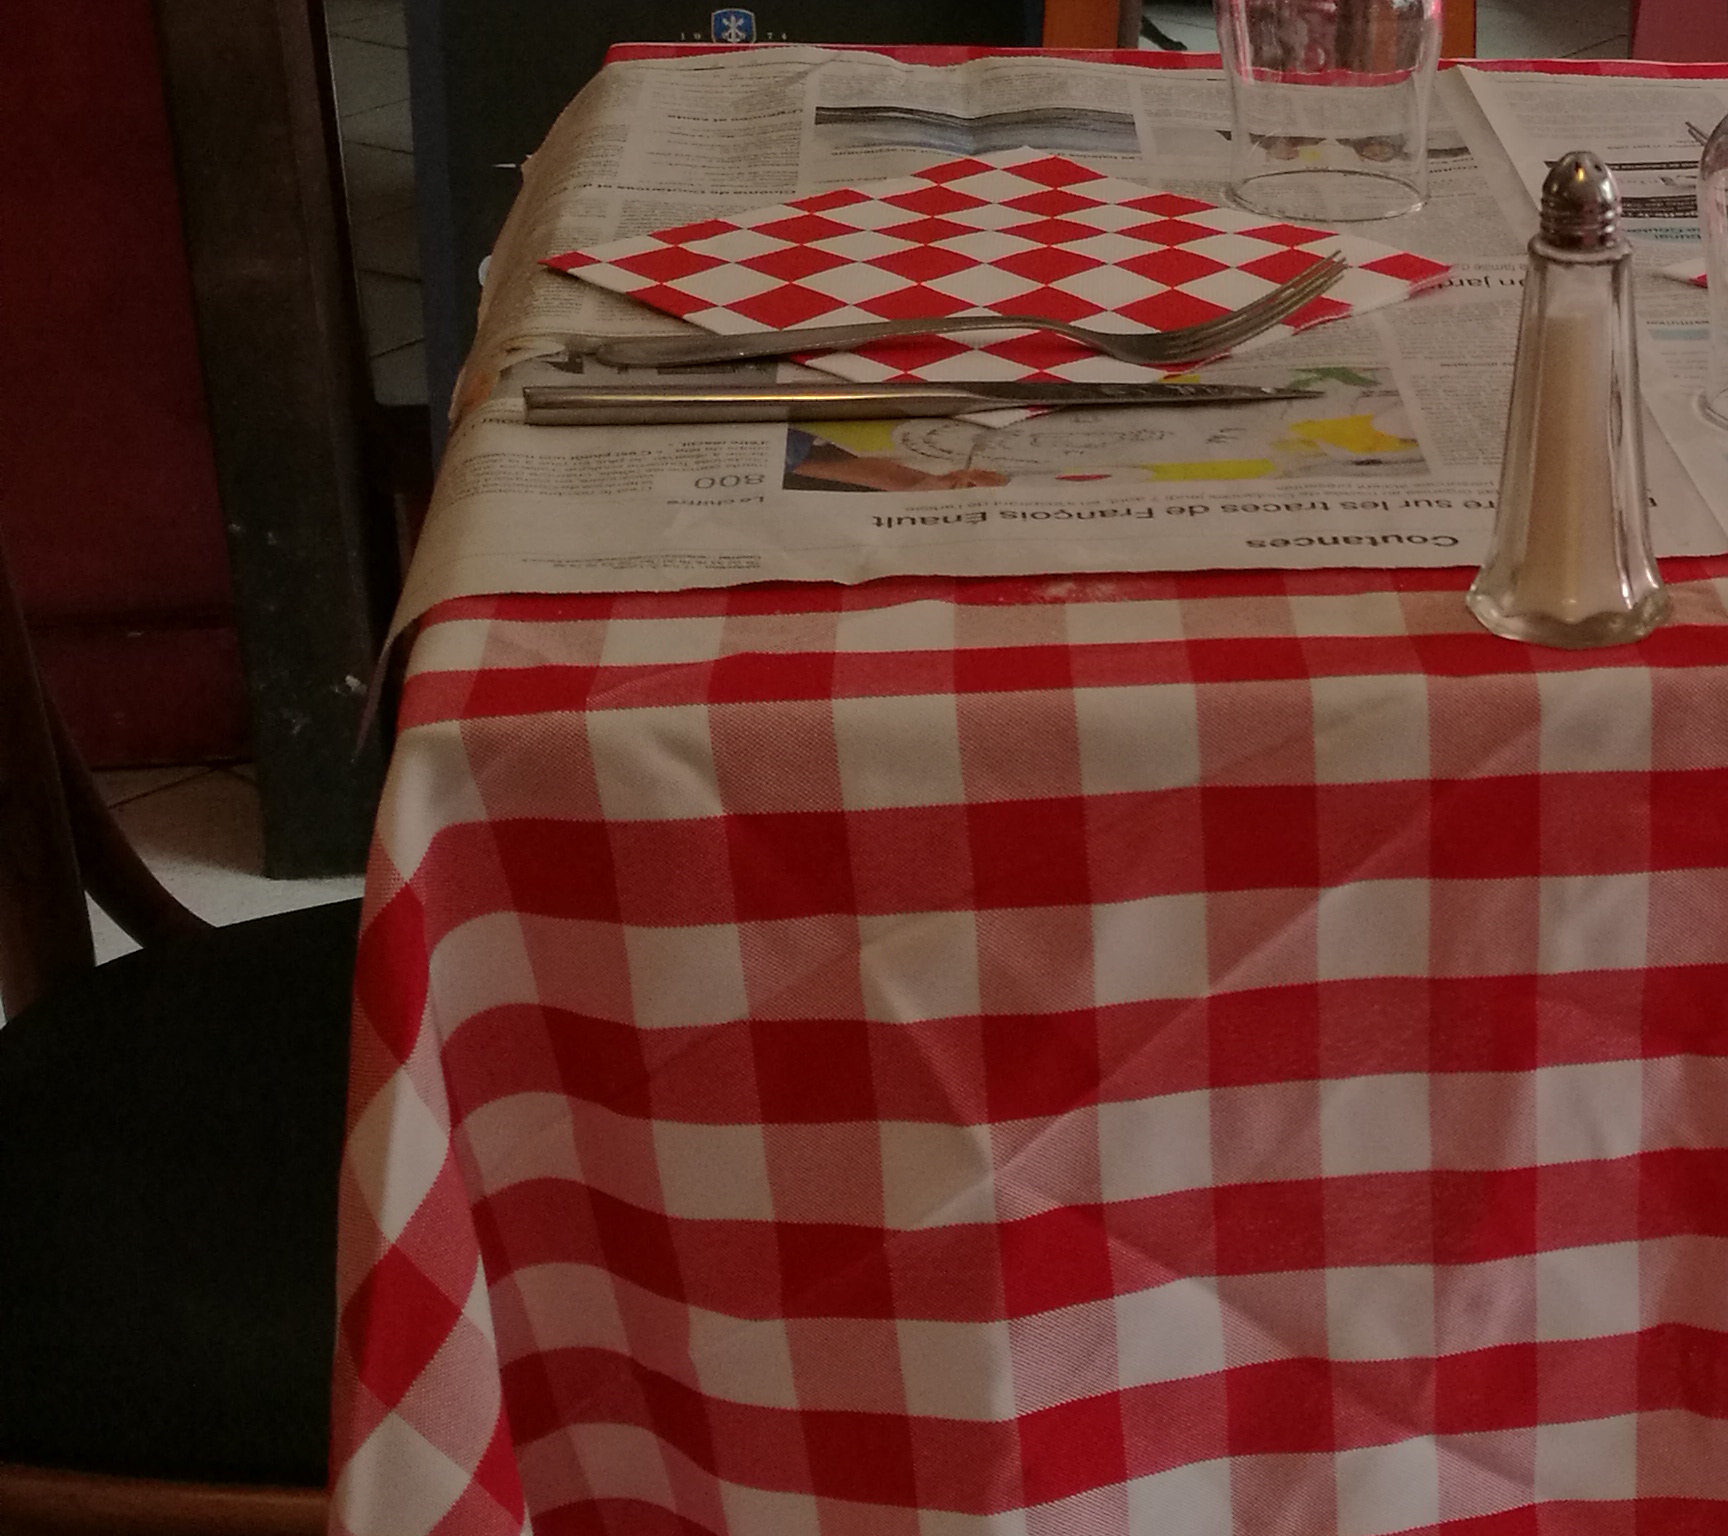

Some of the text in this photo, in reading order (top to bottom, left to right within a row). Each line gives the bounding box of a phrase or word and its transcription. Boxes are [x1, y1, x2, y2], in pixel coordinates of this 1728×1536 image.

[693, 473, 766, 490] 800
[1164, 503, 1210, 517] de
[1219, 502, 1330, 515] traces
[1338, 500, 1389, 513] les
[1397, 498, 1453, 512] sur
[870, 510, 988, 530] Énault
[999, 506, 1154, 524] François
[1245, 531, 1460, 550] Coutances
